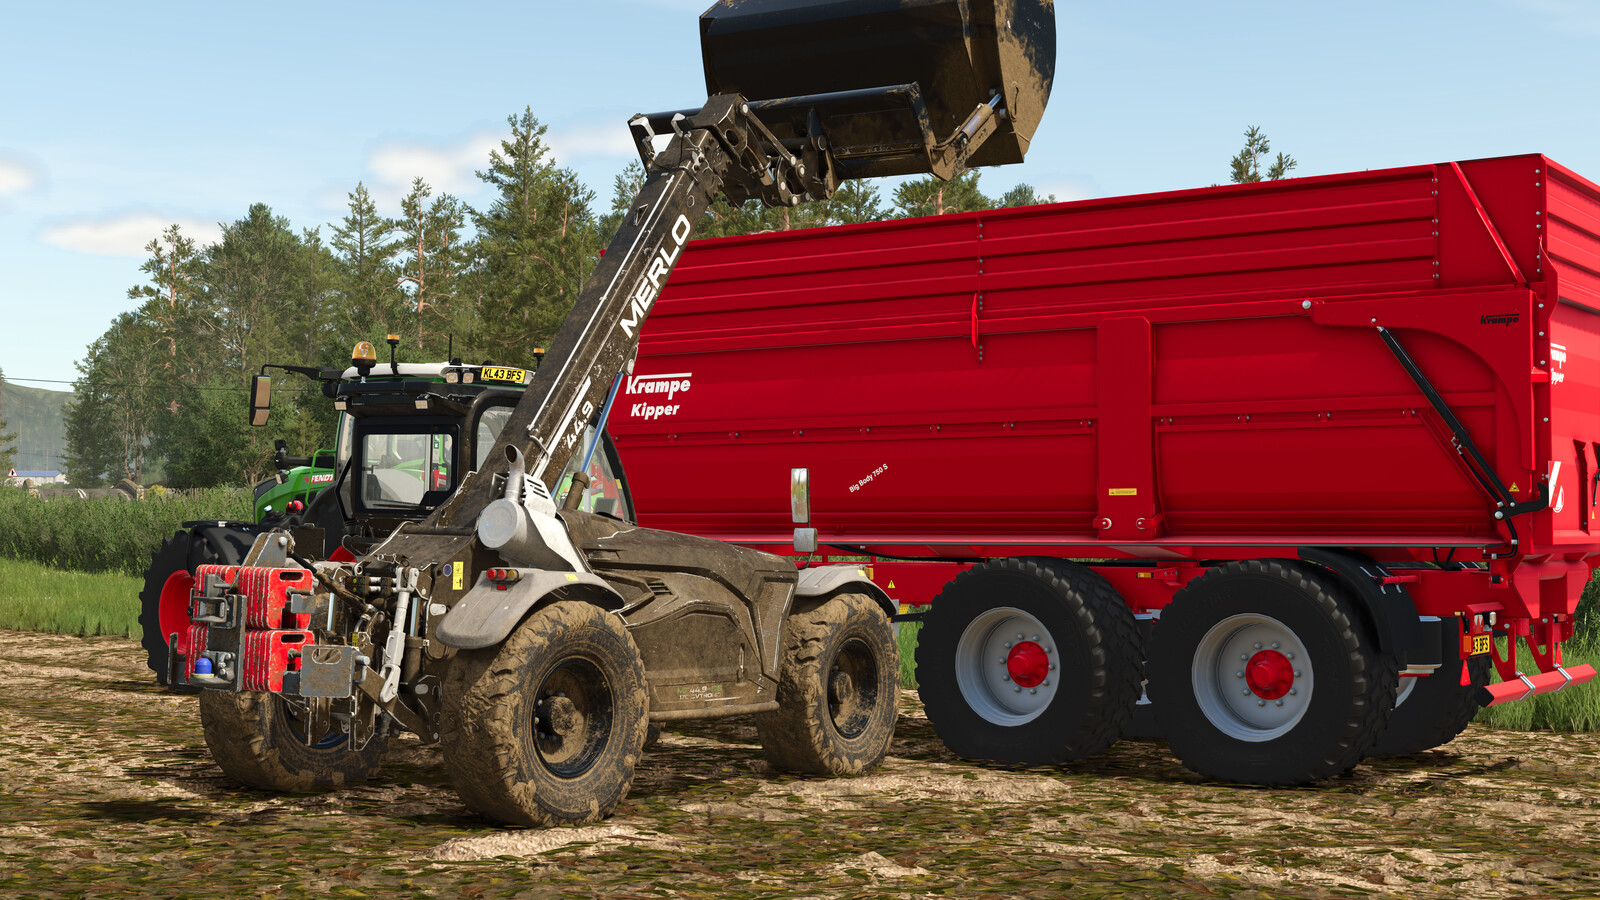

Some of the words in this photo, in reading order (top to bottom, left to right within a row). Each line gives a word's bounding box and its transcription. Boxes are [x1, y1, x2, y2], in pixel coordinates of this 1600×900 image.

[620, 214, 691, 339] MERLO
[484, 369, 505, 379] KL43
[506, 370, 522, 380] BFS
[625, 372, 692, 400] Krampe
[631, 402, 680, 420] Kipper
[567, 401, 594, 449] 44.9
[849, 484, 860, 493] Big
[858, 474, 873, 486] Body
[872, 467, 883, 477] 750
